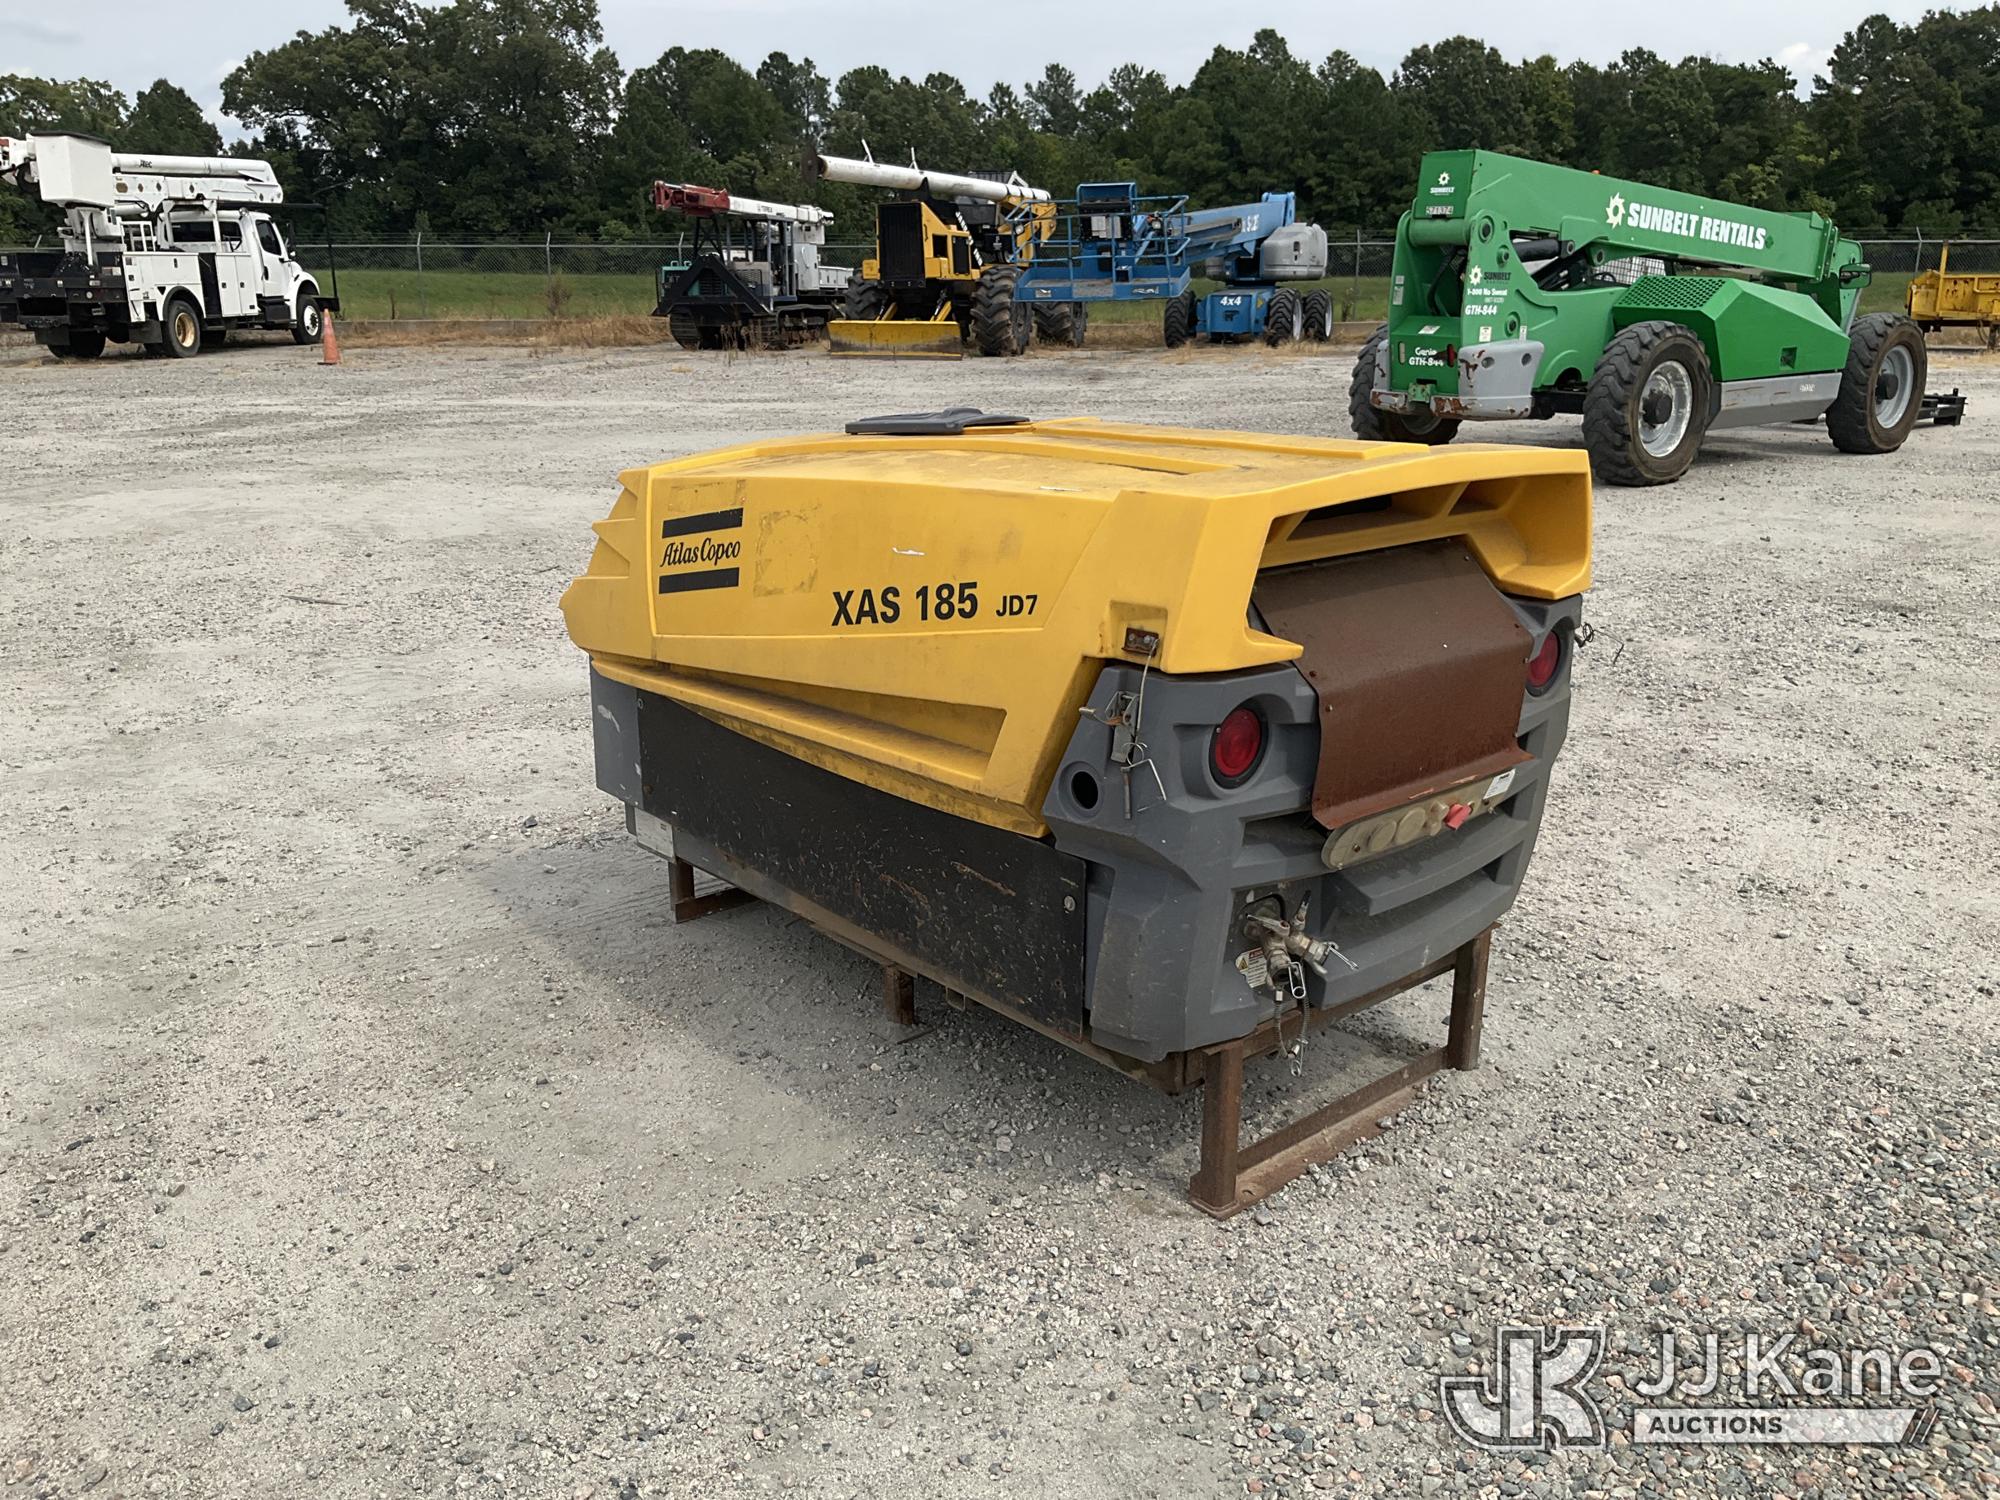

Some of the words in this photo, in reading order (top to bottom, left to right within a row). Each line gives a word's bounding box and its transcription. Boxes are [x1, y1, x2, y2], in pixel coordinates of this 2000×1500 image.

[1627, 202, 1699, 238] SUNBELT
[1699, 216, 1767, 250] RENTALS
[1483, 271, 1512, 281] SUNBELT
[1220, 295, 1242, 306] 4x4
[1465, 304, 1498, 315] GTH-844
[1414, 346, 1438, 356] Genie
[1408, 356, 1444, 367] GTH-844
[660, 541, 700, 568] Atlas
[700, 537, 741, 566] Copco
[831, 586, 901, 627] XAS
[915, 581, 978, 621] 185
[995, 594, 1038, 617] JD7
